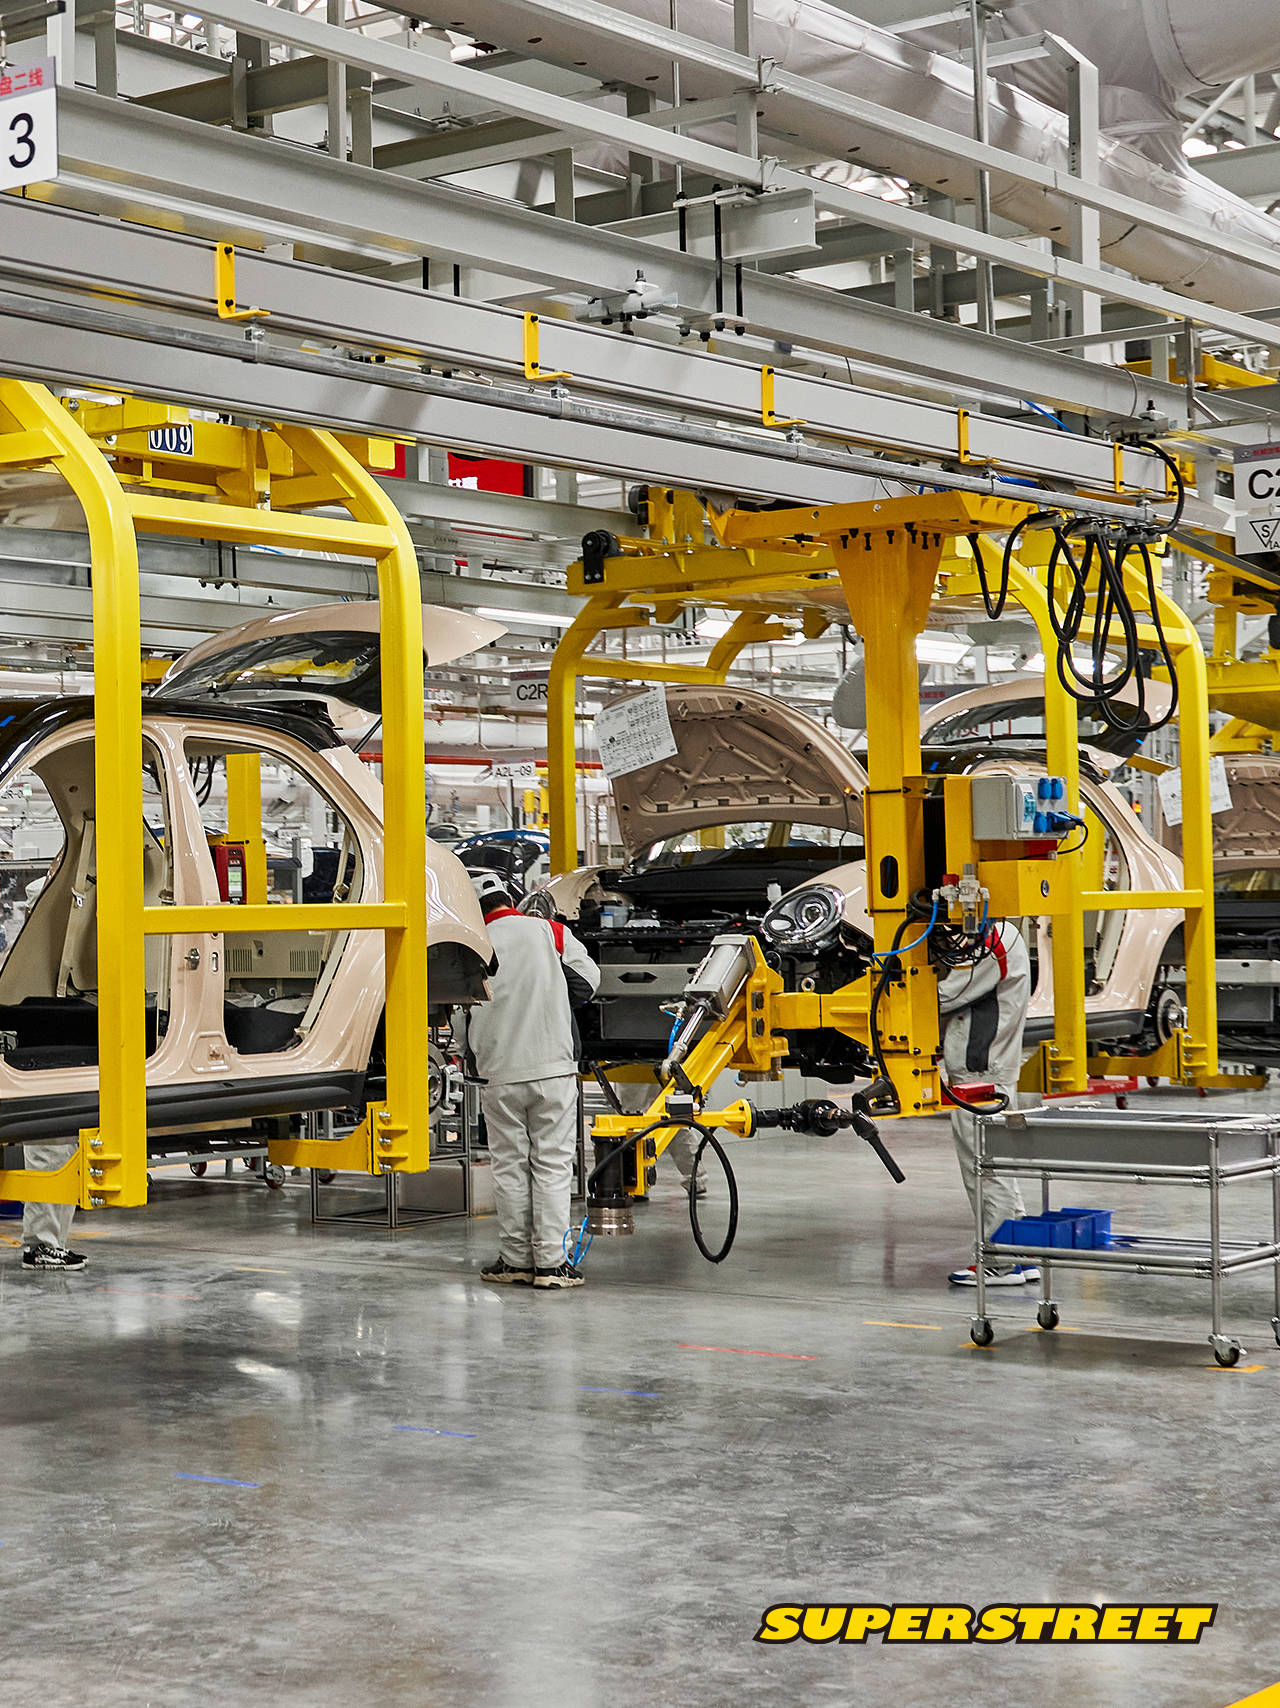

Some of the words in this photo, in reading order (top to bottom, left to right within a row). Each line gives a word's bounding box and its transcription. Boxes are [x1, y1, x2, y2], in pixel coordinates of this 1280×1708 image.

[150, 425, 192, 453] 009
[1248, 468, 1280, 500] C
[1261, 524, 1271, 538] S
